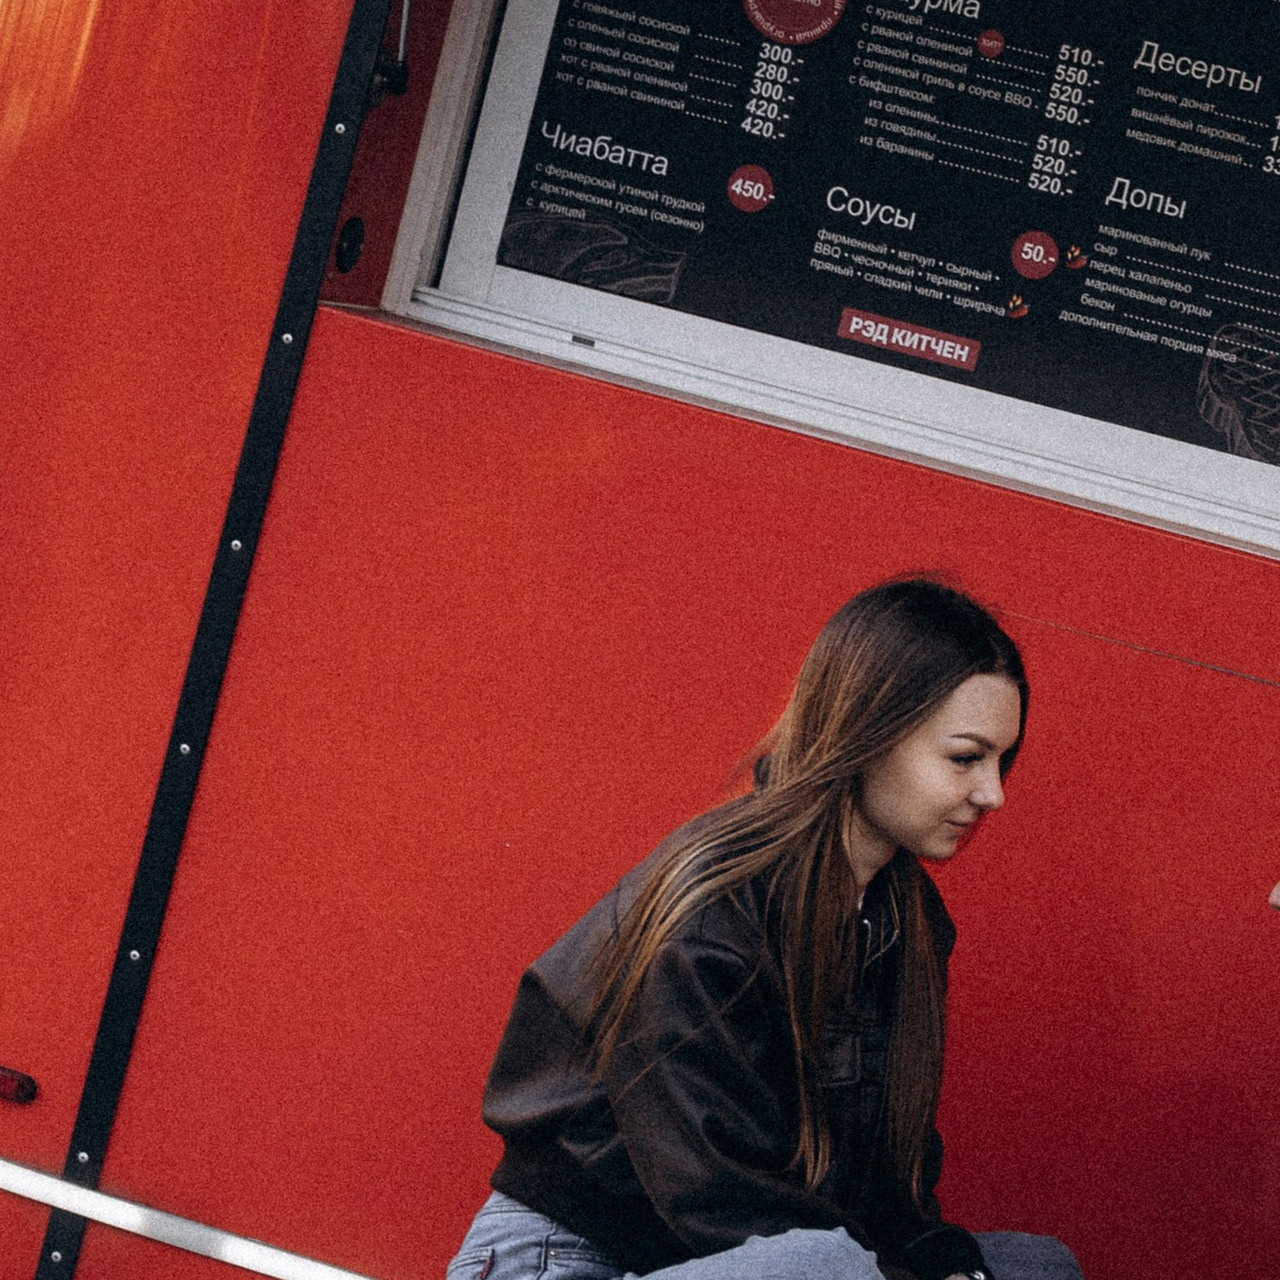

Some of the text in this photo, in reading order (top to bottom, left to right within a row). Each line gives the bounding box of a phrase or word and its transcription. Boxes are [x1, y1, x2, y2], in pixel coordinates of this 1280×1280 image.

[759, 42, 804, 65] 300.-
[1058, 44, 1104, 67] 510.-
[754, 61, 799, 84] 280.-
[1054, 63, 1100, 87] 550.-
[1133, 40, 1262, 93] Десерты
[750, 78, 794, 102] 300.-
[1049, 82, 1094, 106] 520.-
[745, 98, 789, 121] 420.-
[1044, 101, 1090, 125] 550.-
[740, 116, 785, 139] 420.-
[1036, 134, 1081, 157] 510.-
[541, 121, 775, 201] Чиабатта 450.-
[1032, 153, 1077, 176] 520.-
[1028, 172, 1073, 196] 520.-
[618, 184, 659, 201] утиной
[660, 194, 705, 212] грудкой
[1104, 176, 1187, 219] Допы
[826, 185, 1055, 264] Соусы 50.-
[813, 241, 841, 258] BBQ
[897, 250, 936, 268] кетчуп
[809, 258, 854, 277] пряный
[849, 316, 969, 362] РЭД КИТЧЕН
